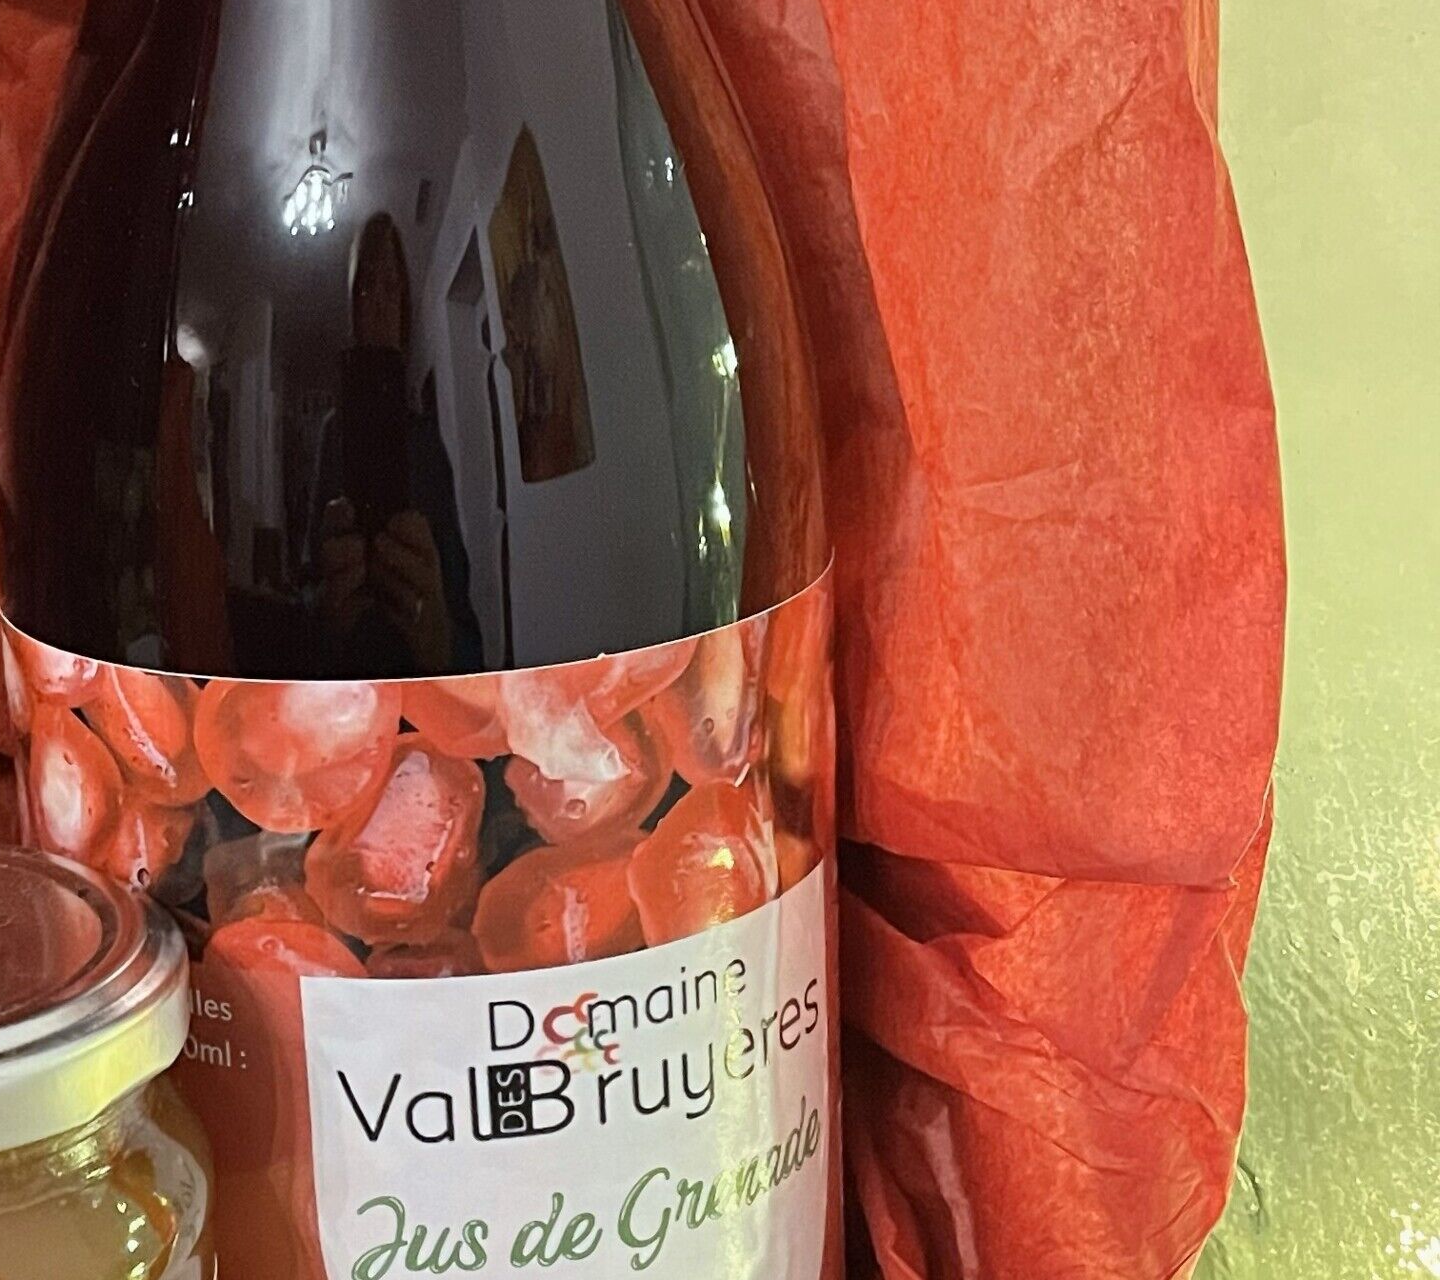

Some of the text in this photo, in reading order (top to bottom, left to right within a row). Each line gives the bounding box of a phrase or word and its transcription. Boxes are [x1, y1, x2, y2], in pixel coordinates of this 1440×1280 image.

[337, 1065, 491, 1143] Val
[510, 1192, 602, 1269] de
[616, 1096, 820, 1270] Grenade
